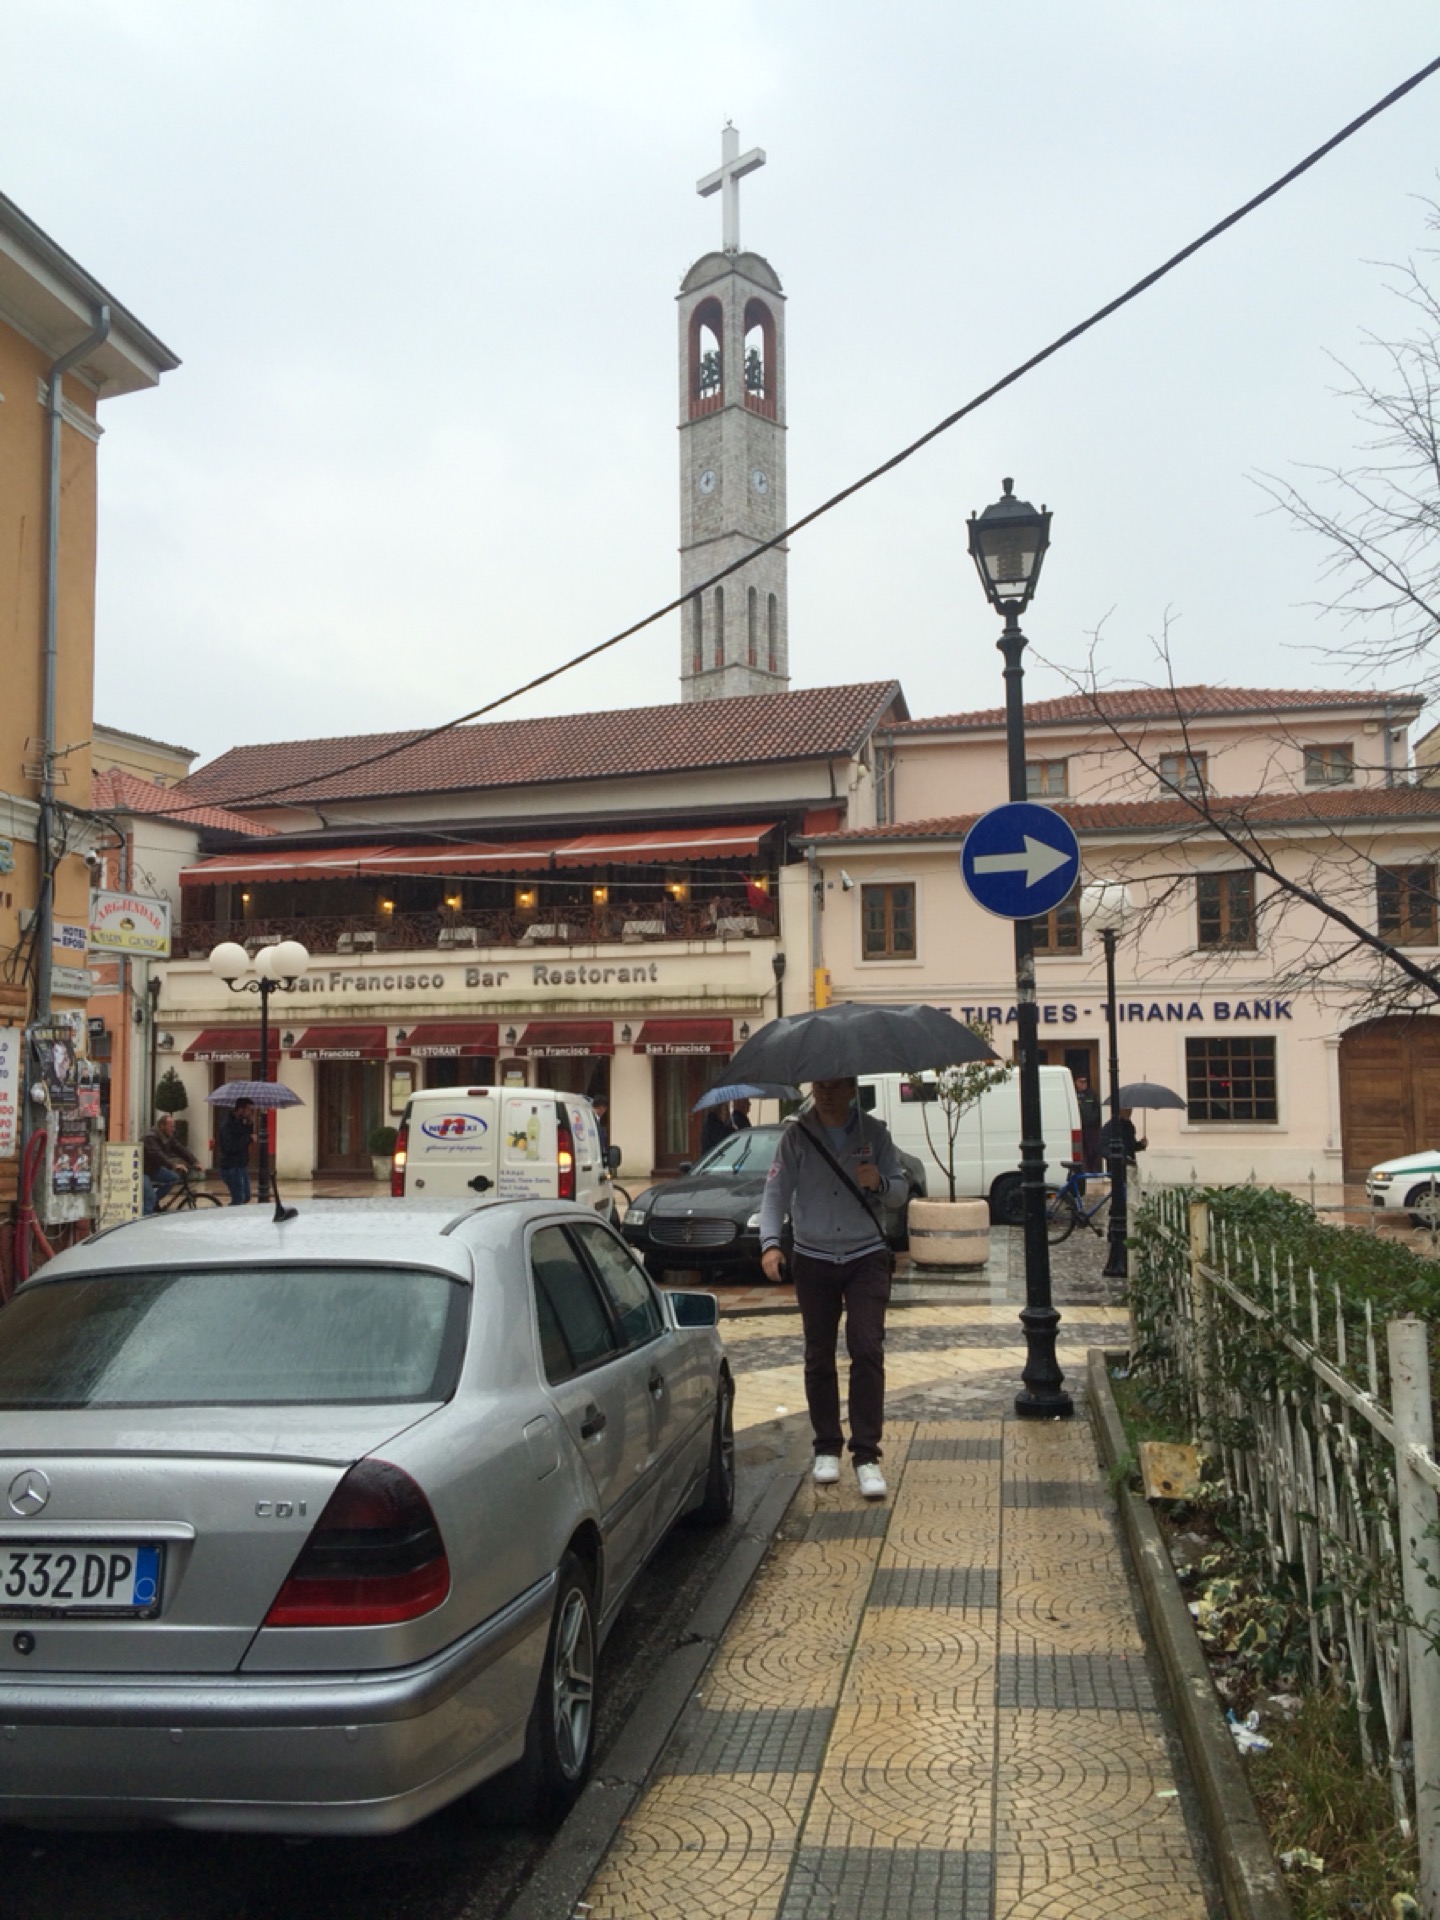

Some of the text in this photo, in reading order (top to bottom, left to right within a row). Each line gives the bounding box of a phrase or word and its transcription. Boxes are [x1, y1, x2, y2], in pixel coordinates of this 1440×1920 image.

[62, 926, 86, 939] HOTEL
[329, 971, 445, 993] Francisco
[465, 967, 510, 988] Bar
[533, 962, 658, 986] Restorant
[961, 1003, 1078, 1024] TIRAES
[1213, 1000, 1293, 1020] BANK
[411, 1046, 462, 1055] RESTORANT
[527, 1046, 590, 1056] San Francisco
[646, 1043, 711, 1053] San Francisco
[194, 1052, 250, 1061] San Francisco
[302, 1049, 361, 1059] San Francisco
[132, 1149, 140, 1220] ARGJEN
[255, 1500, 307, 1518] CDI
